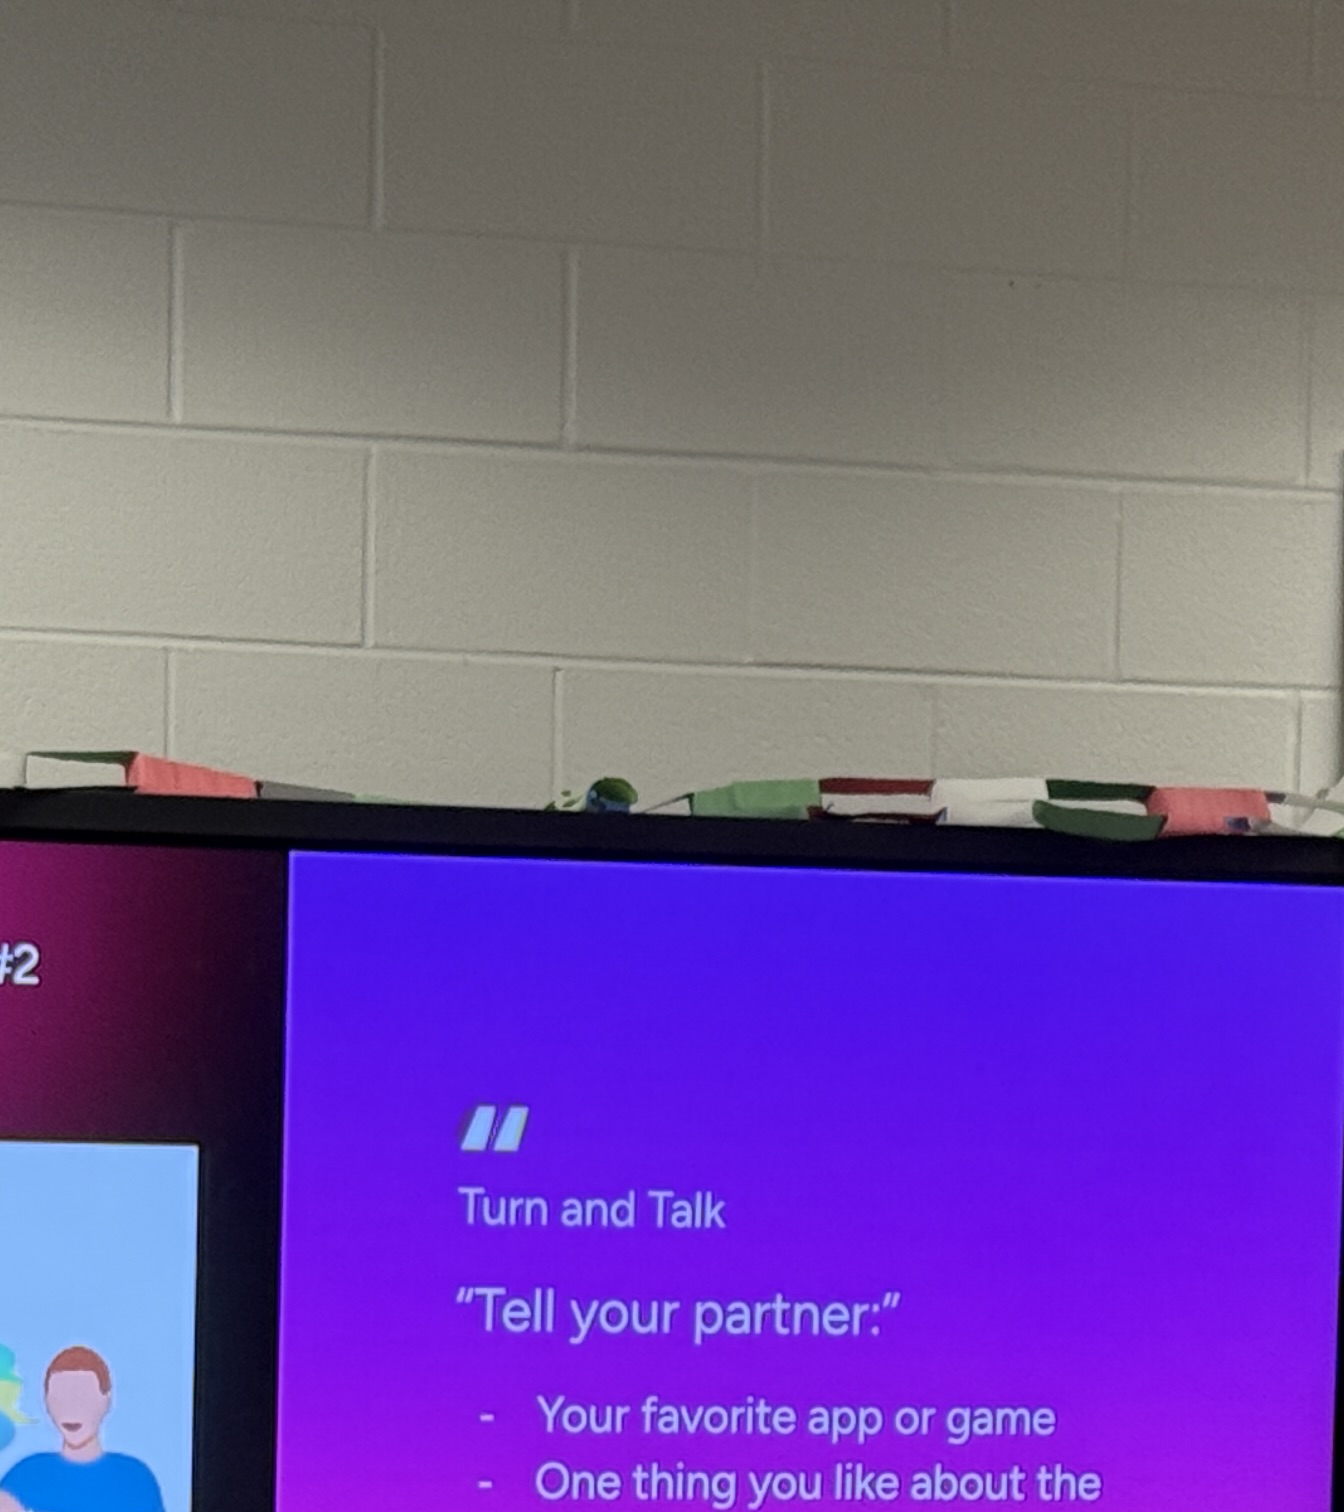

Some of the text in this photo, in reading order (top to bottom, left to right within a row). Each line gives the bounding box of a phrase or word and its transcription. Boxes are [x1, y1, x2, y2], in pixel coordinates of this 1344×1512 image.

[458, 1186, 727, 1230] Turn and Talk
[569, 1295, 681, 1344] your
[536, 1395, 631, 1435] Your
[641, 1395, 797, 1436] favorite
[807, 1404, 883, 1444] app
[894, 1405, 937, 1436] or
[945, 1404, 1057, 1445] game
[534, 1461, 624, 1501] One
[632, 1461, 737, 1510] thing
[747, 1471, 822, 1510] you
[834, 1463, 900, 1501] like
[909, 1464, 1026, 1502] about
[1037, 1465, 1103, 1502] the
